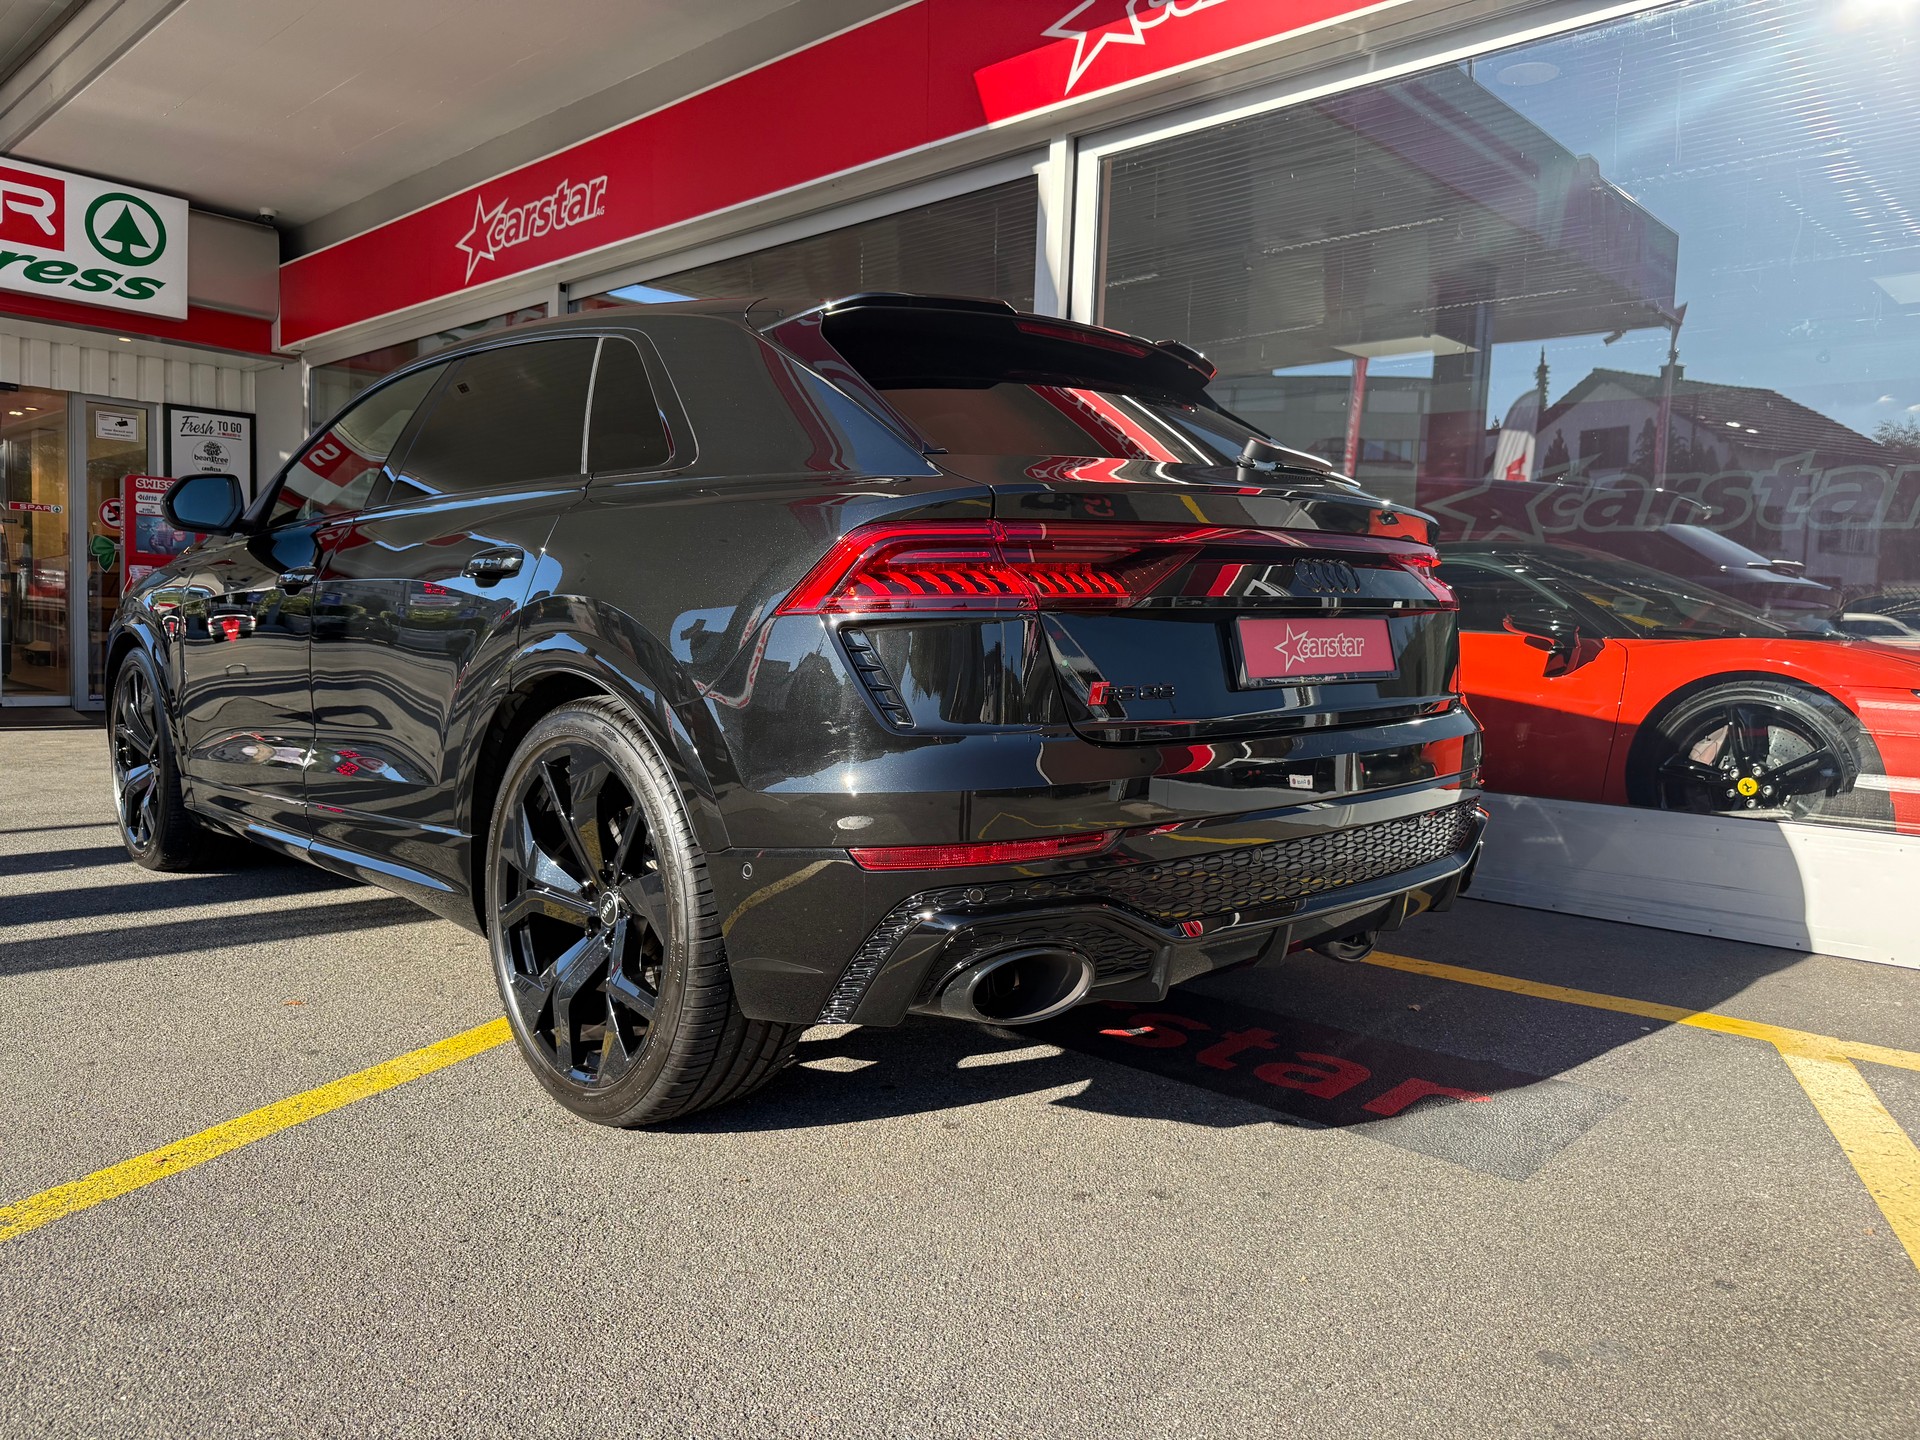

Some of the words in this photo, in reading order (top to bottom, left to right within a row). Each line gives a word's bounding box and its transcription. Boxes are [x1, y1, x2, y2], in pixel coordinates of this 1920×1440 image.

[0, 178, 57, 236] R
[490, 175, 608, 252] carstar
[0, 250, 166, 300] ress
[180, 416, 215, 435] Fresh
[217, 421, 229, 432] TO
[230, 423, 242, 434] GO
[19, 503, 51, 512] SPAR
[1298, 632, 1365, 658] carstar
[1098, 1013, 1492, 1116] star
